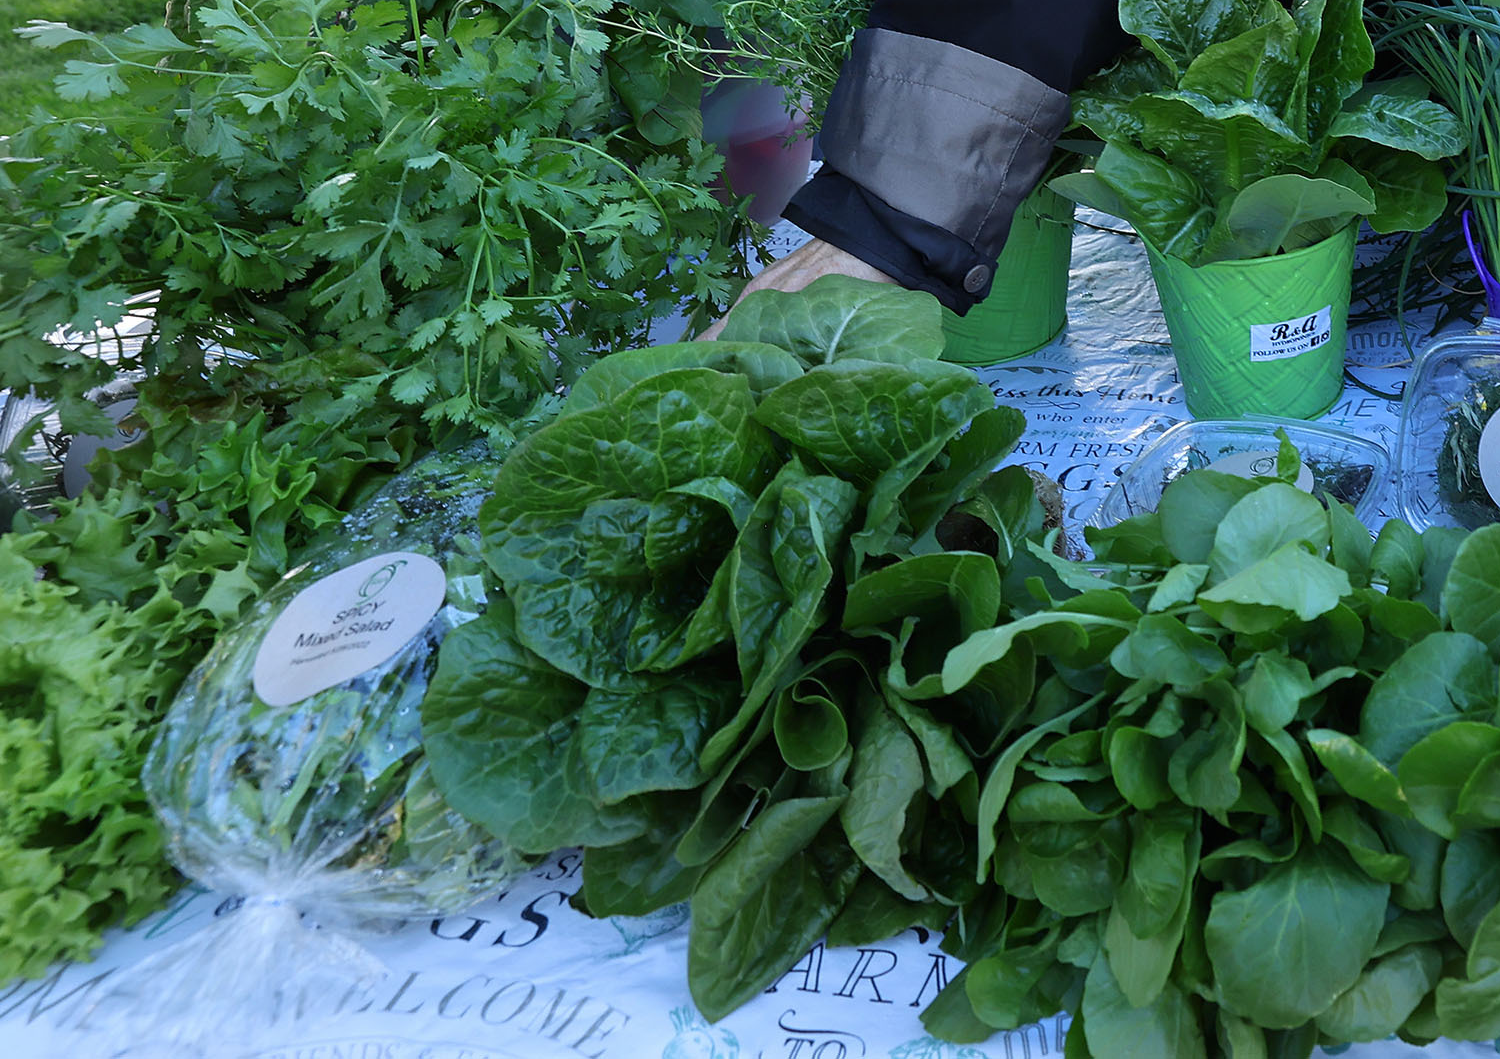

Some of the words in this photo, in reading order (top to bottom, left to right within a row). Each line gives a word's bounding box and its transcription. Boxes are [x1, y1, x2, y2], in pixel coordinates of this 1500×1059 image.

[1270, 315, 1318, 341] R&A
[1253, 349, 1286, 357] FOLLOW
[1287, 346, 1297, 354] US
[1297, 343, 1309, 351] ON
[1037, 383, 1085, 398] this
[1095, 384, 1184, 405] Home
[1037, 412, 1073, 423] who
[1083, 415, 1128, 424] enter
[332, 600, 387, 625] SPICY
[294, 627, 344, 649] Mixed
[344, 618, 396, 638] Salad
